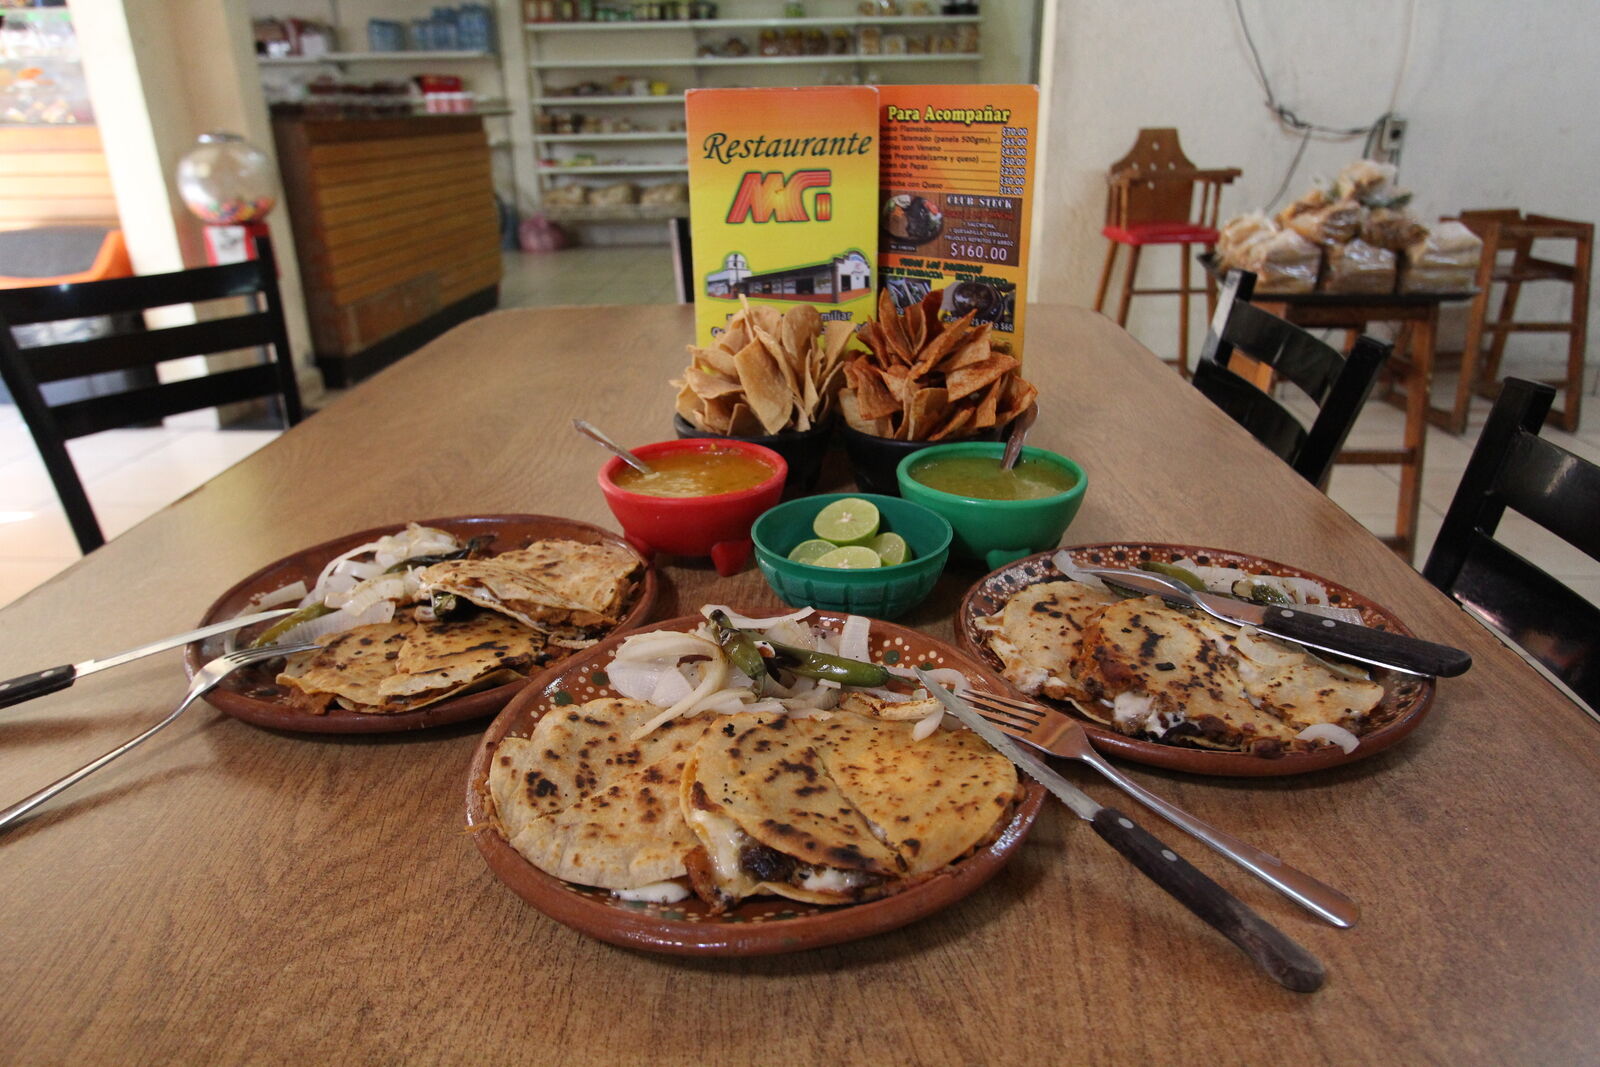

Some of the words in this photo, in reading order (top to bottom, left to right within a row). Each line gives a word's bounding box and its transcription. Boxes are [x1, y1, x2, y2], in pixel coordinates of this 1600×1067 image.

[888, 105, 920, 121] Para
[924, 105, 1011, 126] Acompañar
[703, 132, 873, 165] Restaurante
[947, 195, 974, 206] CLUB
[980, 198, 1012, 210] STECK
[950, 242, 1008, 261] $160.00
[820, 310, 853, 321] miliar
